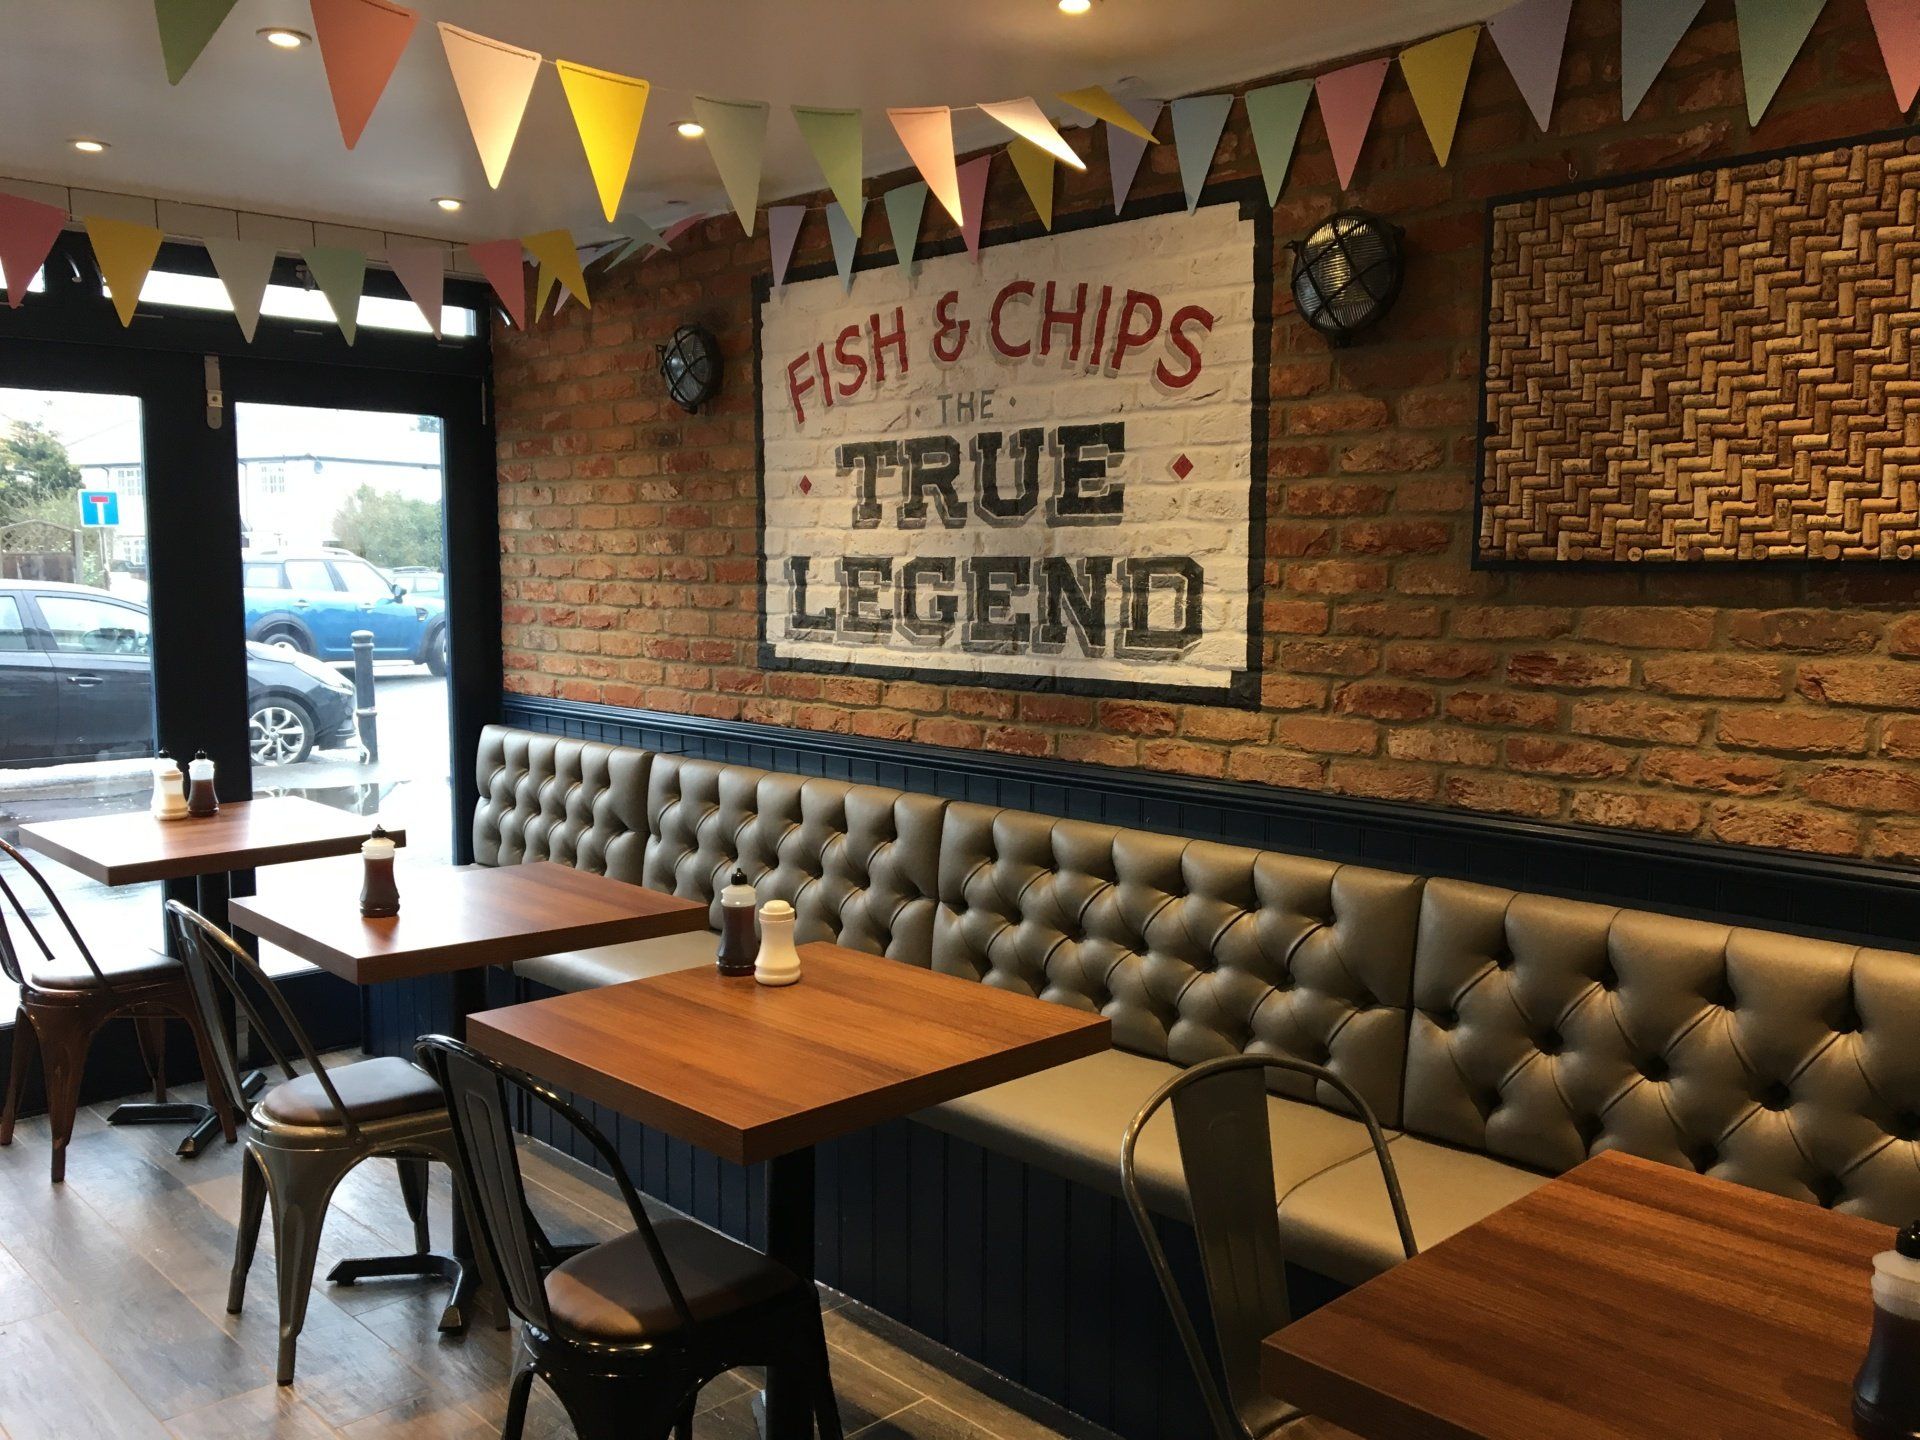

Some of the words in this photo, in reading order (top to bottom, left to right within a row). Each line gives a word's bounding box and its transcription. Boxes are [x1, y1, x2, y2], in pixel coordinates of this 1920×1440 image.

[786, 305, 909, 425] FISH
[932, 290, 971, 363] &
[990, 280, 1216, 390] CHIPS
[937, 389, 995, 424] THE
[835, 421, 1126, 530] TRUE
[784, 555, 1205, 661] LEGEND
